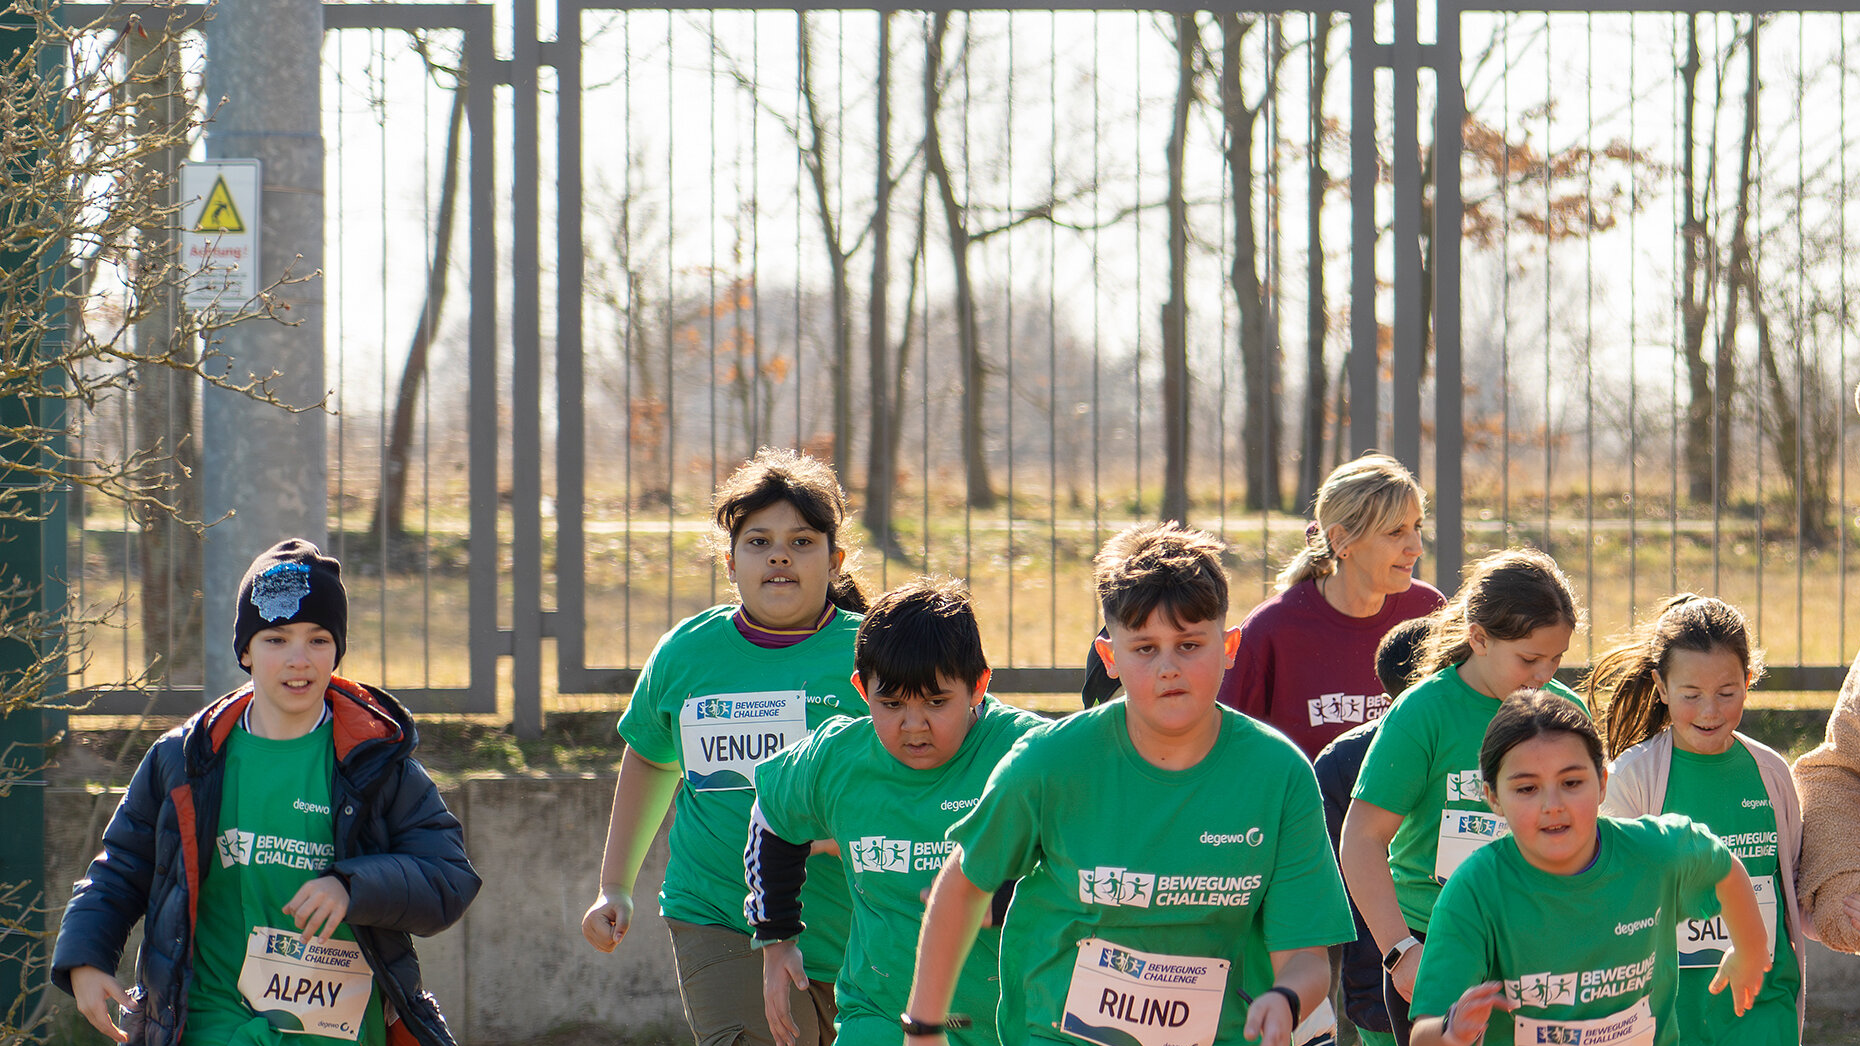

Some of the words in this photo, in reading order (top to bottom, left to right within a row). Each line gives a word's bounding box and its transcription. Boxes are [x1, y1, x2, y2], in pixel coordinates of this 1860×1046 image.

[735, 699, 786, 710] BEWEGUNGS
[733, 709, 780, 718] CHALLENGE
[293, 798, 330, 815] degewo
[940, 797, 979, 812] degewo
[1200, 831, 1244, 847] degewo
[1720, 831, 1777, 846] BEWEGUNG
[1731, 844, 1776, 858] HALLENGE
[1157, 875, 1262, 891] BEWEGUNGS
[1155, 892, 1251, 906] CHALLENGE
[1614, 917, 1654, 936] degewo
[1687, 916, 1729, 942] SAL
[308, 945, 360, 960] BEWEGUNGS
[304, 953, 352, 968] CHALLENGE
[1148, 963, 1207, 975] BEWEGUNGS
[1580, 951, 1656, 987] BEWEGUNG
[1143, 972, 1198, 984] CHALLENGE
[263, 973, 343, 1008] ALPAY
[1098, 987, 1190, 1028] RILIND
[317, 1021, 340, 1031] degewo
[1585, 1013, 1639, 1038] BEWEGUNGS
[1583, 1025, 1633, 1046] CHALLENGE
